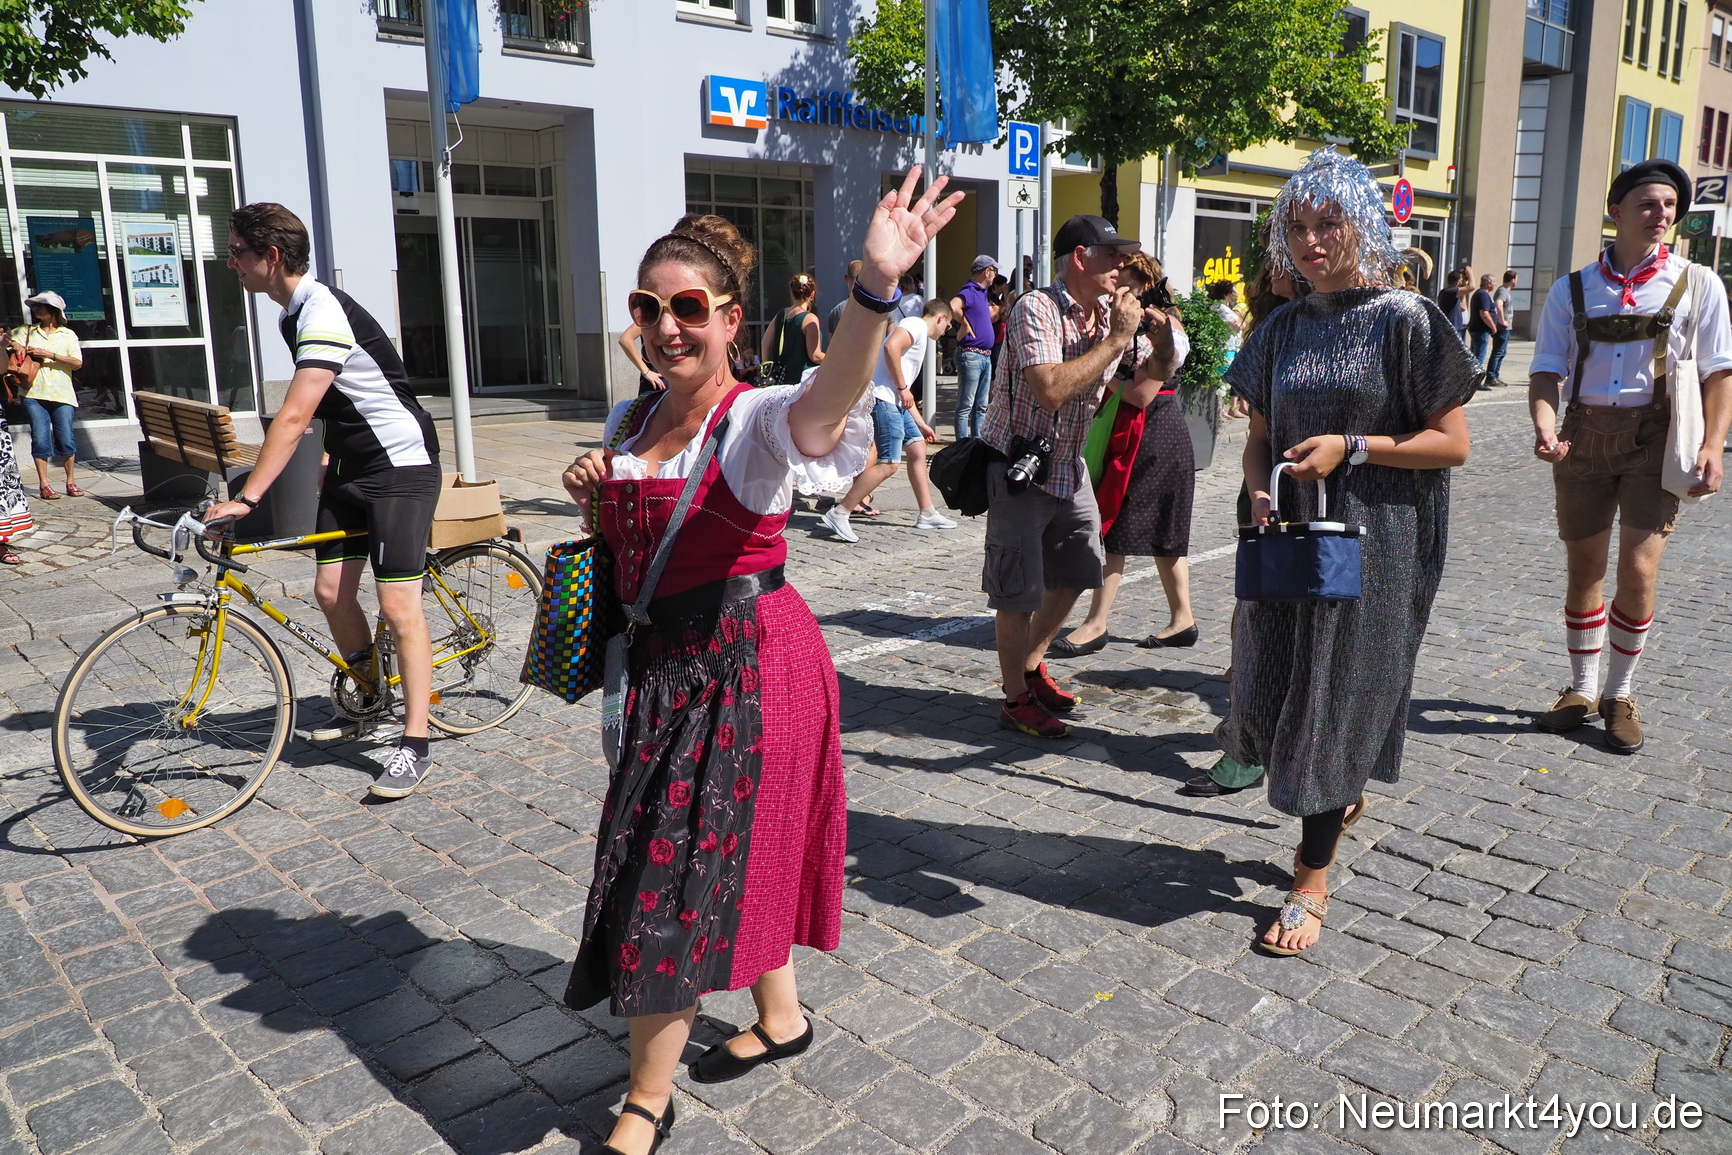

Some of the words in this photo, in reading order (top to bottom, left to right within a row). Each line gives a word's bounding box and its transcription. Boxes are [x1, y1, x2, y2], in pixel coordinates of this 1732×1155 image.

[775, 86, 991, 146] Raiffeisen
[1016, 129, 1033, 169] P
[1203, 257, 1241, 285] SALE
